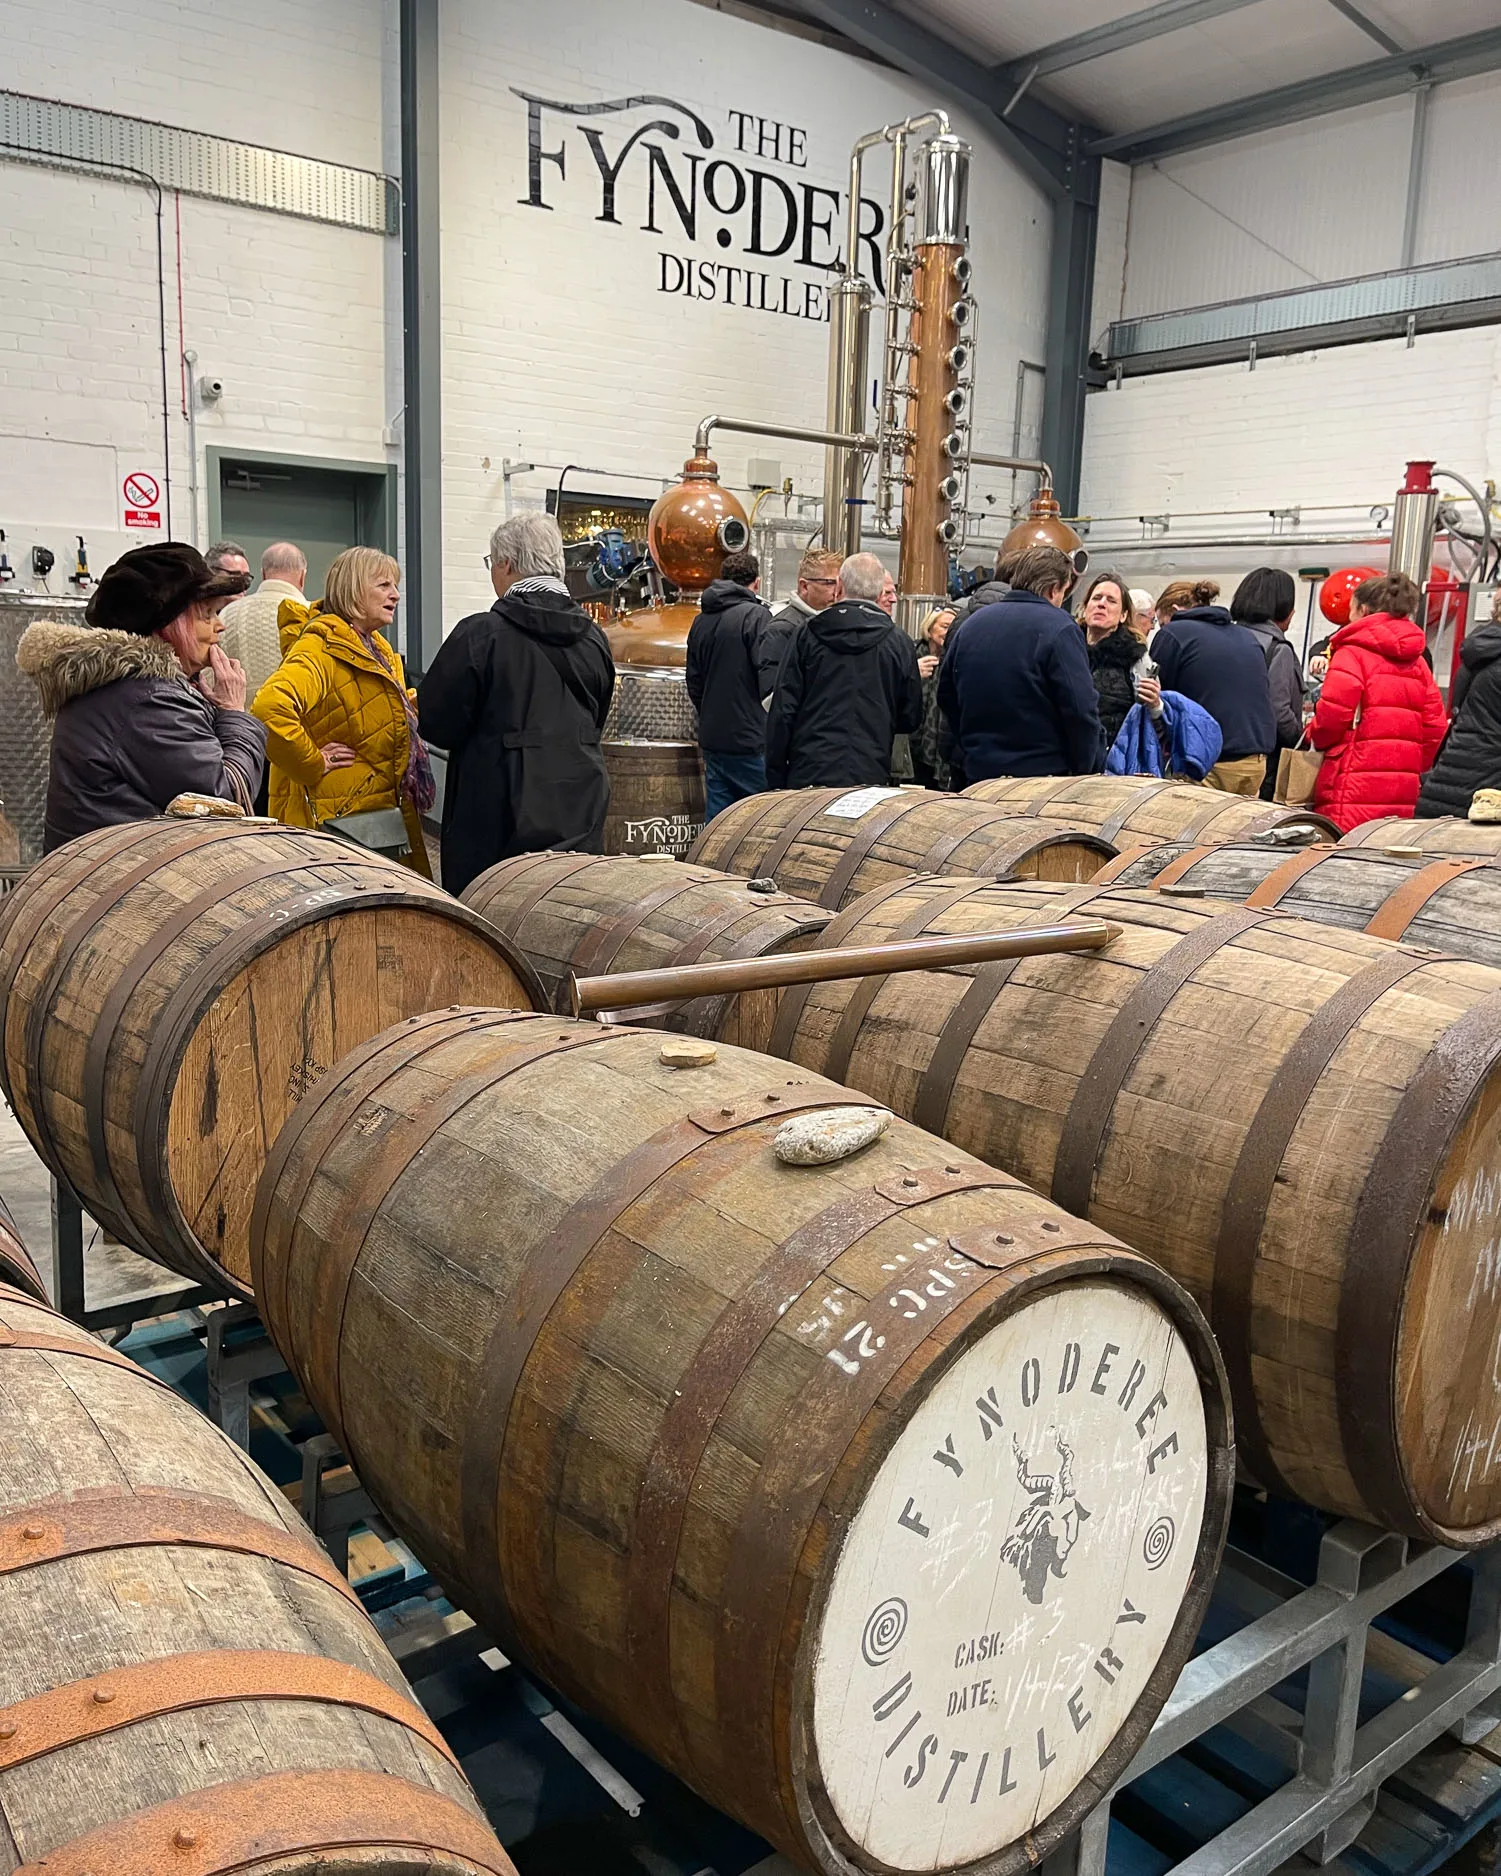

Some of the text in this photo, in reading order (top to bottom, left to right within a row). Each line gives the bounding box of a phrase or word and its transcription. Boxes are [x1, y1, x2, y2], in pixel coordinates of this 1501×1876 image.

[728, 109, 808, 169] THE
[657, 251, 831, 323] DISTILLE
[127, 518, 159, 528] smoking
[137, 511, 149, 519] No
[671, 814, 690, 825] THE
[898, 1342, 1179, 1539] FYNODEREE
[872, 1597, 1147, 1805] DISTILLERY
